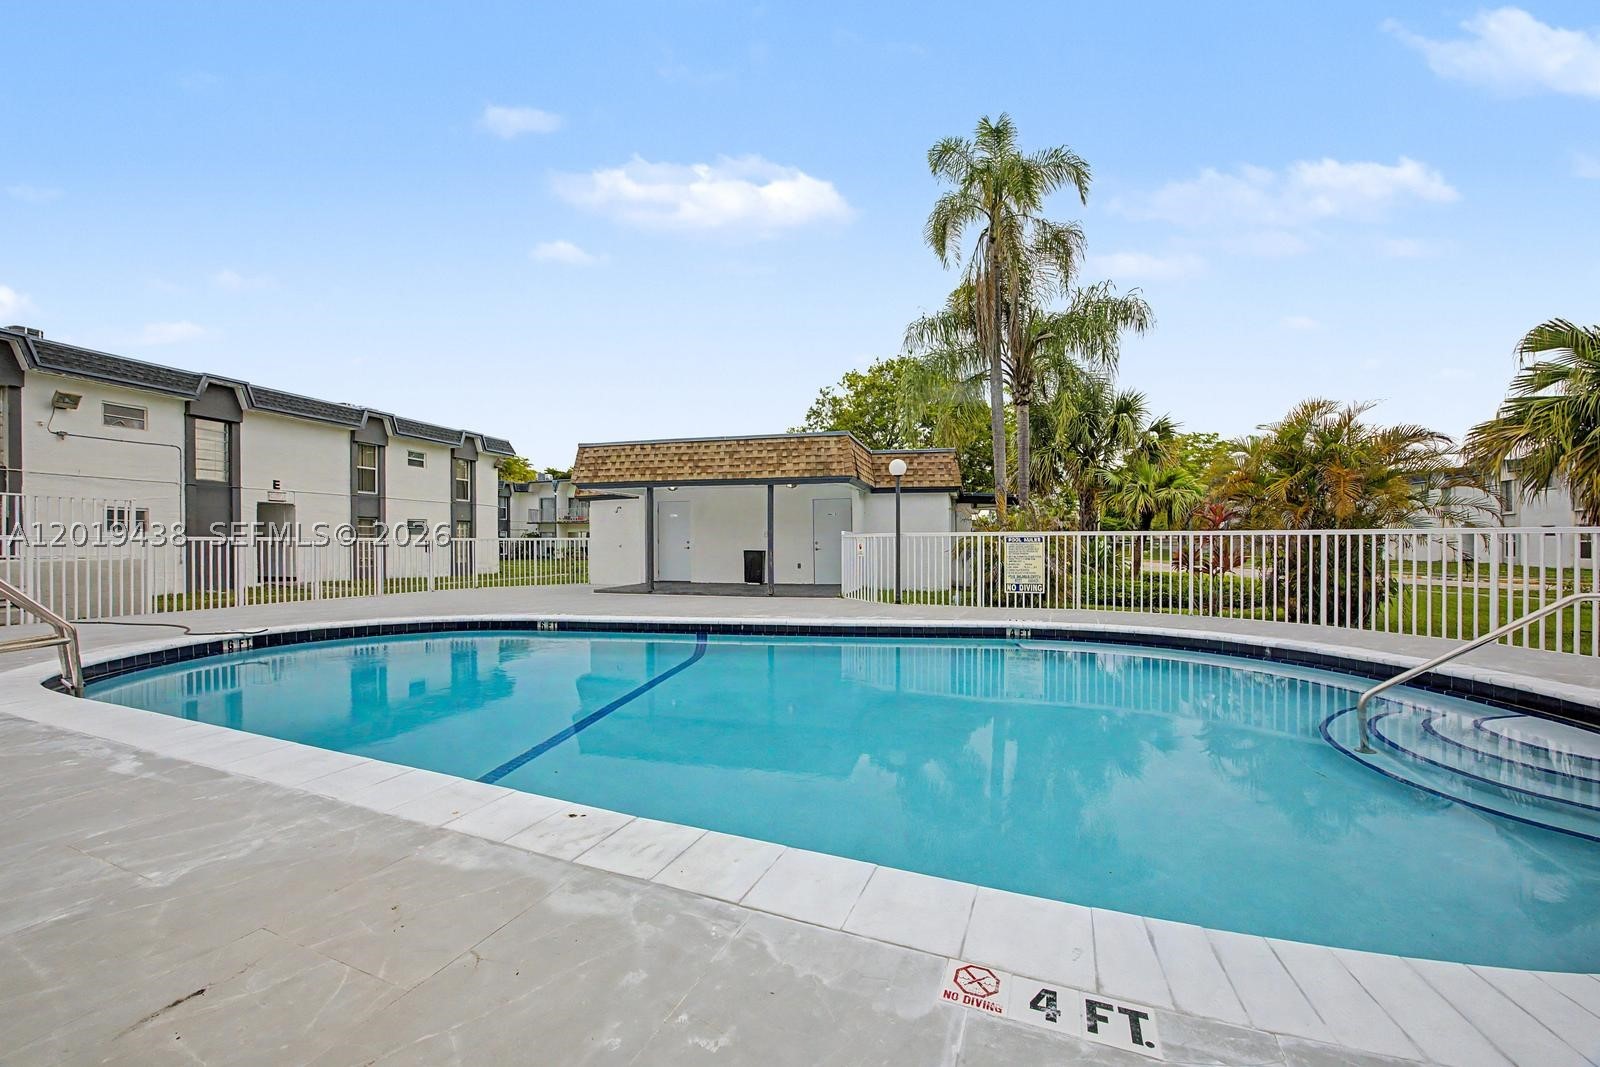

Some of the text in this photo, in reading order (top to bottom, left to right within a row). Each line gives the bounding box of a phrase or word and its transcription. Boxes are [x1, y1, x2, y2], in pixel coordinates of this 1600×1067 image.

[272, 480, 280, 490] E
[1007, 584, 1043, 592] NO DIVING
[943, 989, 1003, 1014] NO DIVING
[1029, 988, 1156, 1049] 4 FT.
